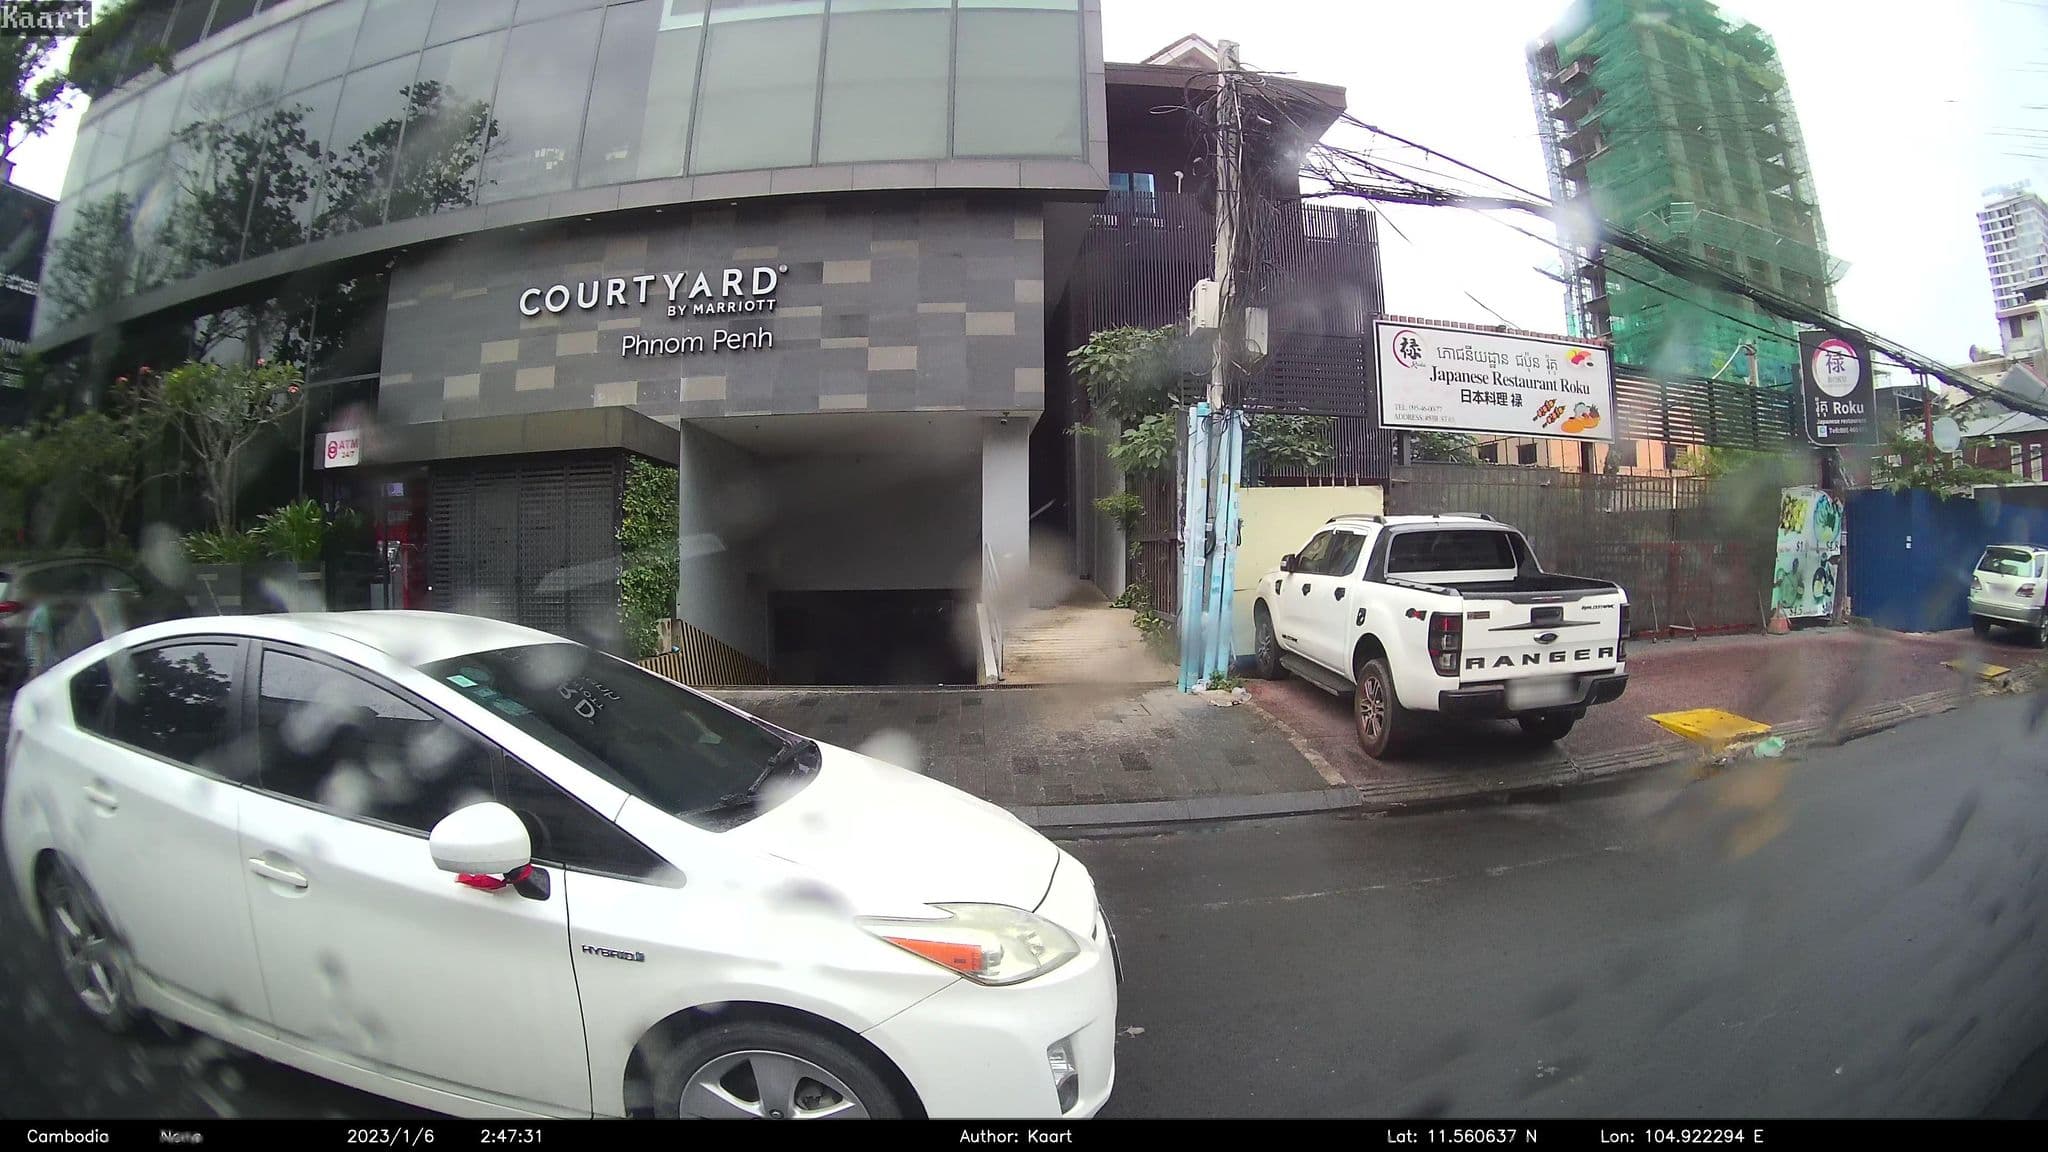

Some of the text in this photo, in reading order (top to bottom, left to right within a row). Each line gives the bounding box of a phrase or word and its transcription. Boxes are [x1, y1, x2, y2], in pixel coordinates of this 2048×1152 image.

[667, 299, 777, 317] BY MARRIOTT
[621, 326, 773, 357] Phnom Penh
[1430, 366, 1590, 395] Japanese Restaurant Roku
[1460, 389, 1508, 407] 日本料理
[1833, 401, 1864, 414] Roku
[339, 439, 359, 449] ATM
[1465, 647, 1614, 670] RANGER
[581, 945, 635, 961] HYBRID
